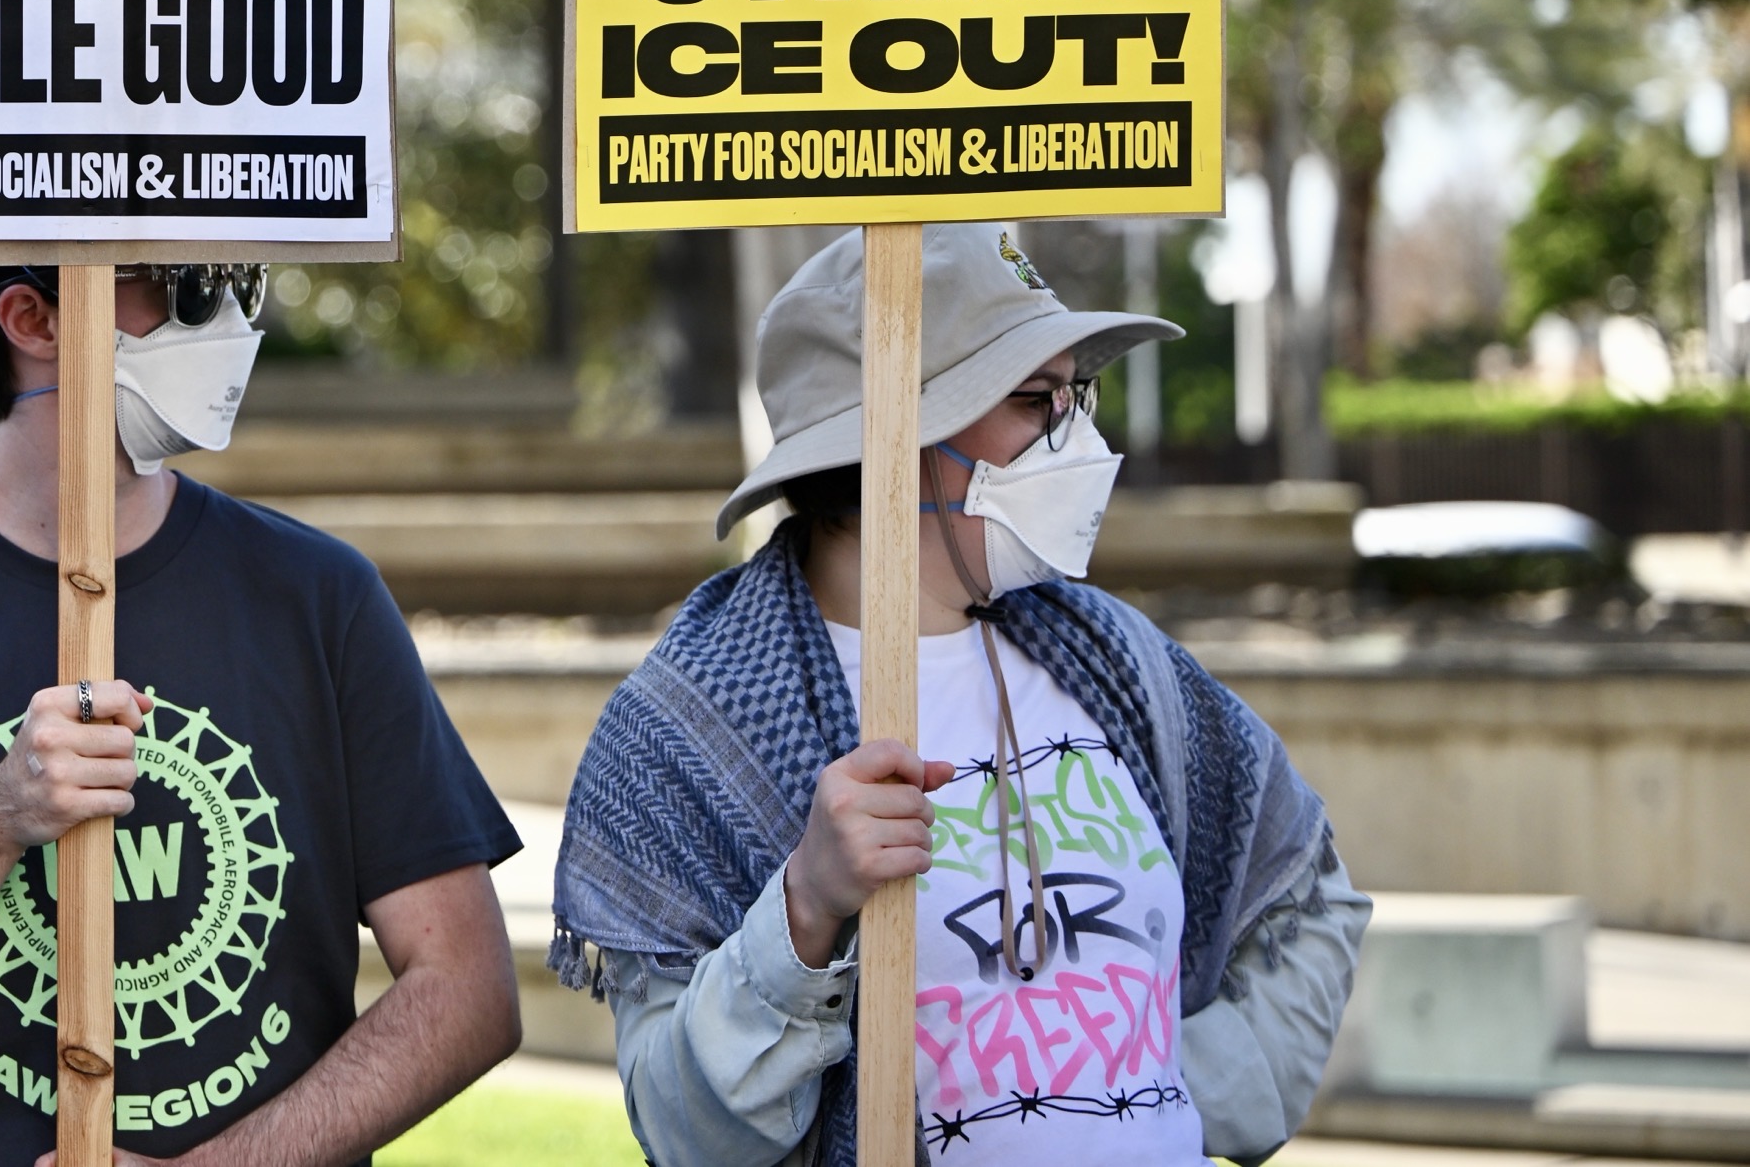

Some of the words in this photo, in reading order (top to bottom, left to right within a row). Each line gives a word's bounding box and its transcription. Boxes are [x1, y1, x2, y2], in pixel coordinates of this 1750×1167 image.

[602, 21, 822, 98] ICE
[850, 13, 1190, 93] OUT!
[136, 154, 176, 199] &
[183, 153, 354, 200] LIBERATION
[609, 133, 709, 184] PARTY
[715, 132, 775, 181] FOR
[780, 128, 951, 179] SOCIALISM
[959, 128, 998, 176] &
[1004, 120, 1178, 173] LIBERATION
[136, 747, 166, 765] TED
[167, 760, 235, 853] AUTOMOBILE,
[200, 858, 237, 948] AEROSPACE
[114, 968, 170, 992] AGRICU
[173, 945, 203, 974] AND
[114, 1036, 271, 1131] EGION
[261, 1002, 291, 1045] 6
